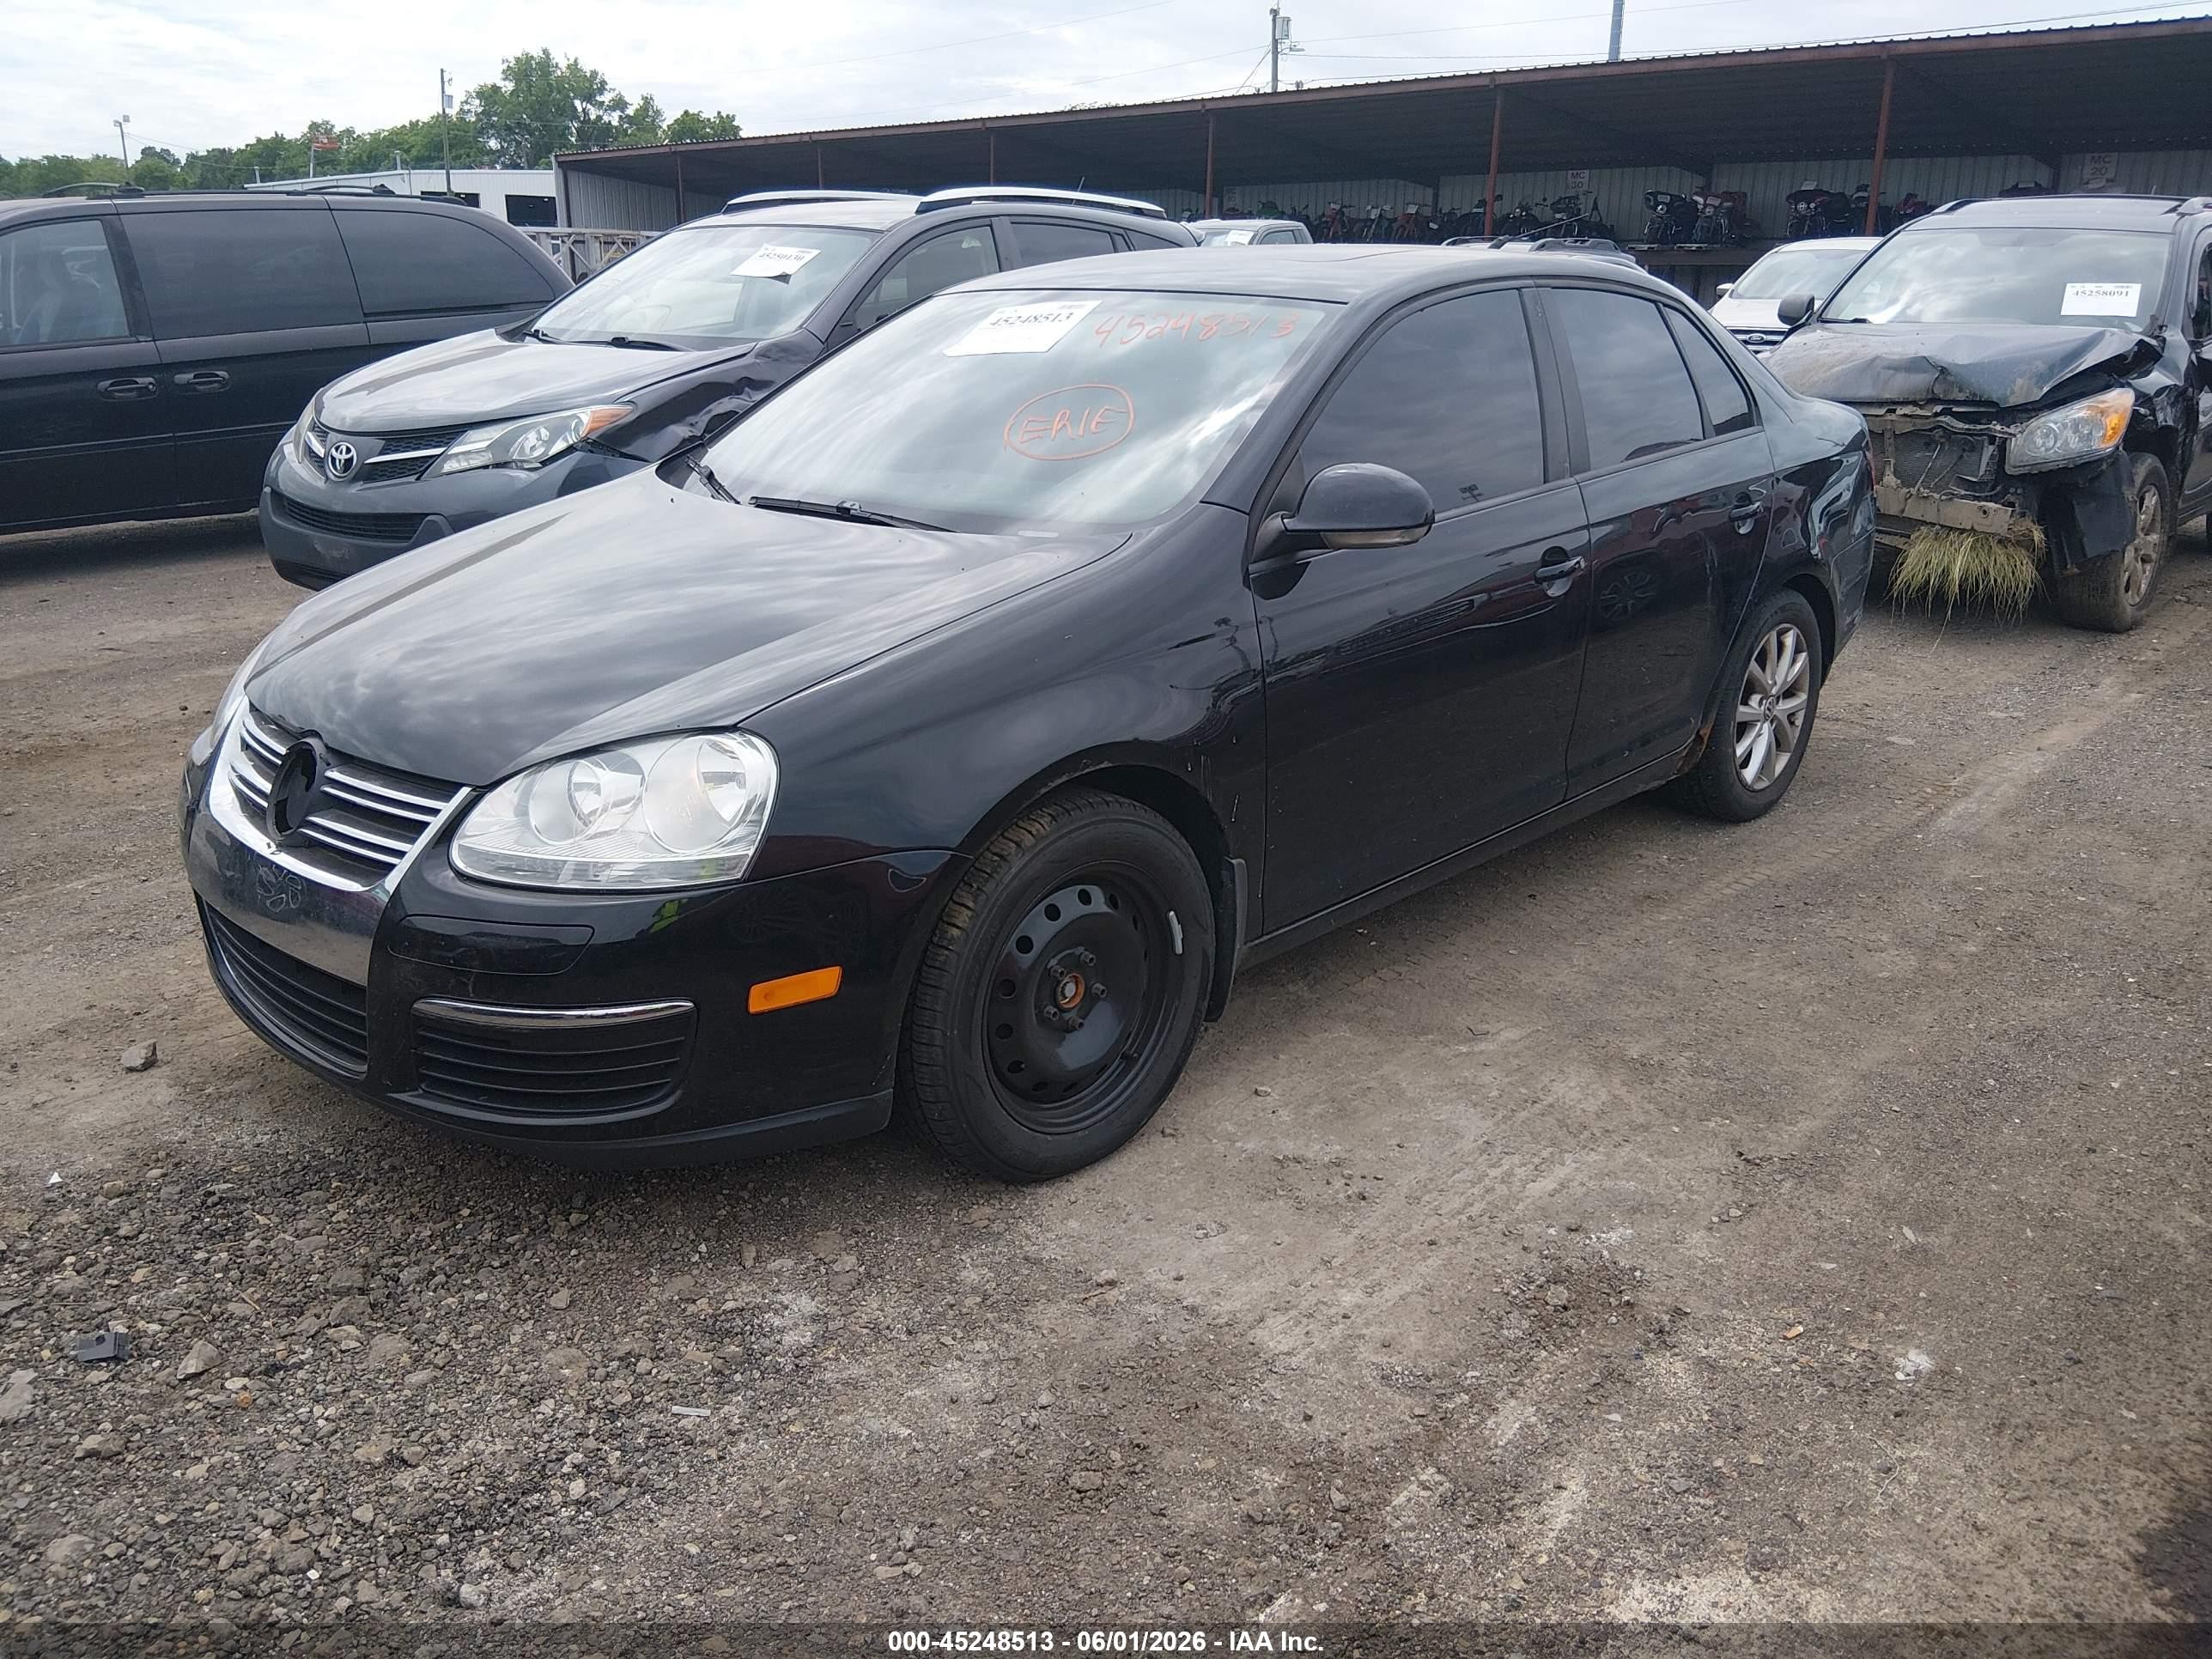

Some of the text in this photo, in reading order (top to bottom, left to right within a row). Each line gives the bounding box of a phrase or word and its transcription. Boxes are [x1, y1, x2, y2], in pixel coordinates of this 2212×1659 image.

[2090, 155, 2111, 164] MC
[2090, 167, 2108, 175] 20
[989, 312, 1074, 326] 45248513
[1095, 312, 1299, 348] 45248513
[1019, 406, 1127, 444] ERIE
